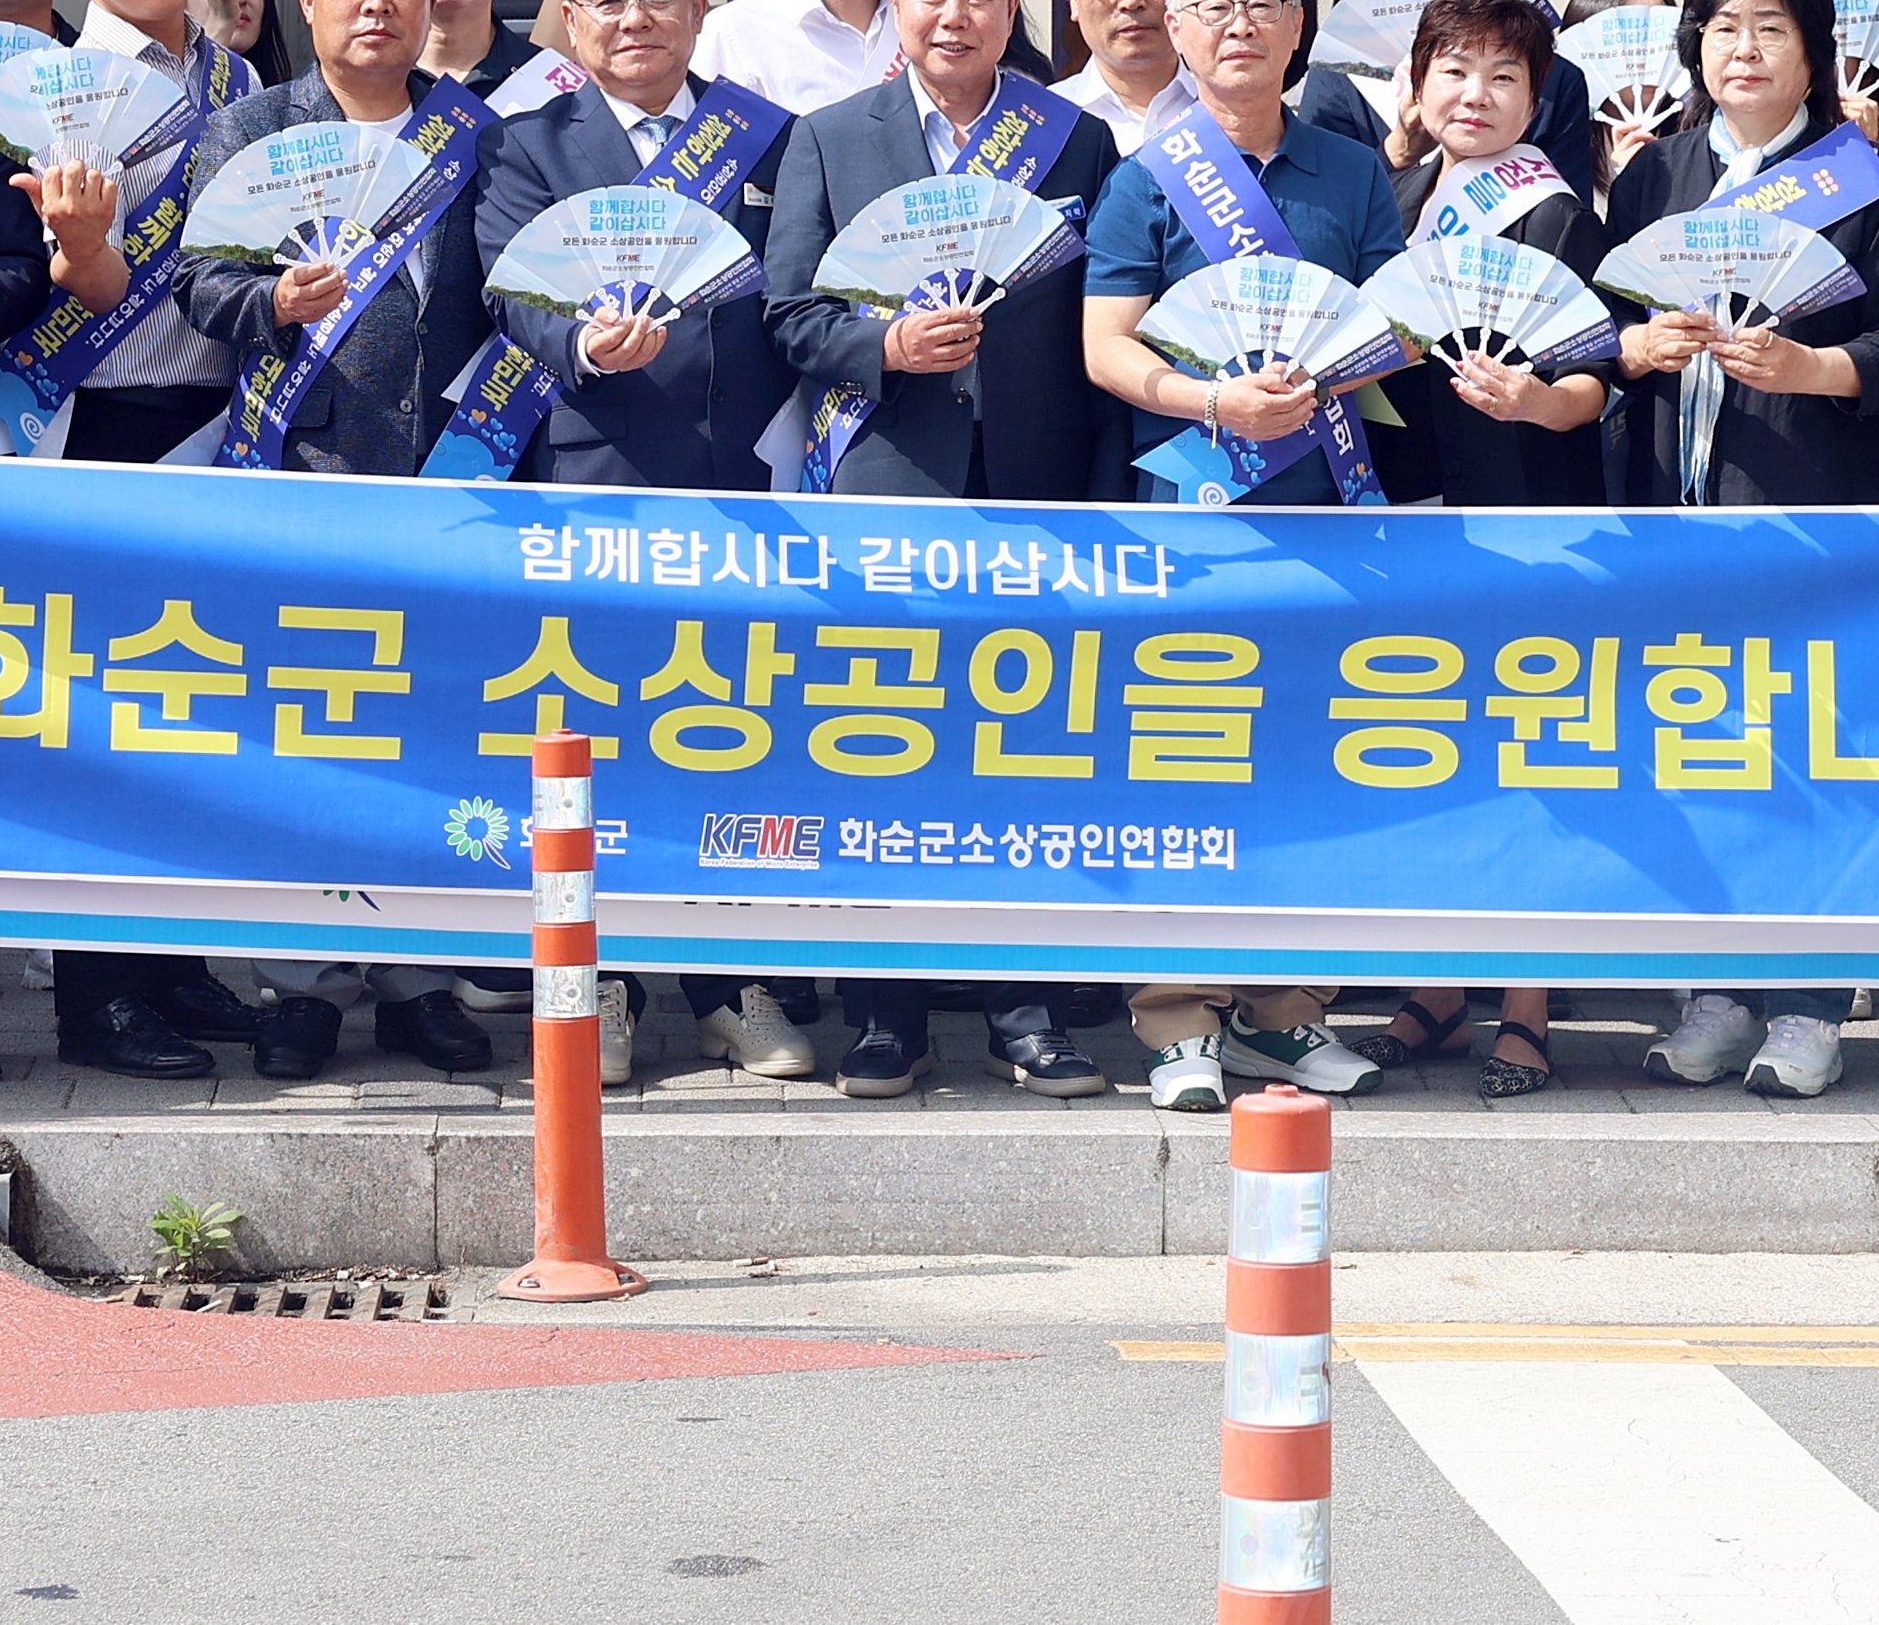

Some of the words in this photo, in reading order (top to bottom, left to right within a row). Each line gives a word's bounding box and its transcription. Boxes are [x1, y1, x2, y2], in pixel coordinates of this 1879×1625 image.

[266, 131, 340, 160] 함께합시다
[270, 148, 343, 175] 같이삽시다
[589, 199, 665, 214] 함께합시다
[902, 185, 976, 207] 함께합시다
[589, 215, 665, 230] 같이삽시다
[905, 202, 979, 226] 같이삽시다
[1683, 216, 1759, 234] 함께합시다
[124, 195, 186, 266] 함께하
[563, 236, 580, 245] 모든
[583, 237, 608, 246] 화순군
[611, 236, 652, 246] 소상공인을
[655, 236, 697, 245] 응원합니다
[1684, 232, 1760, 249] 같이삽시다
[519, 523, 835, 592] 함께합시다
[862, 531, 1175, 600] 같이삽시다
[478, 617, 1265, 786] 소상공인을
[699, 812, 824, 858] KFME
[839, 817, 1235, 871] 화순군소상공인연합회
